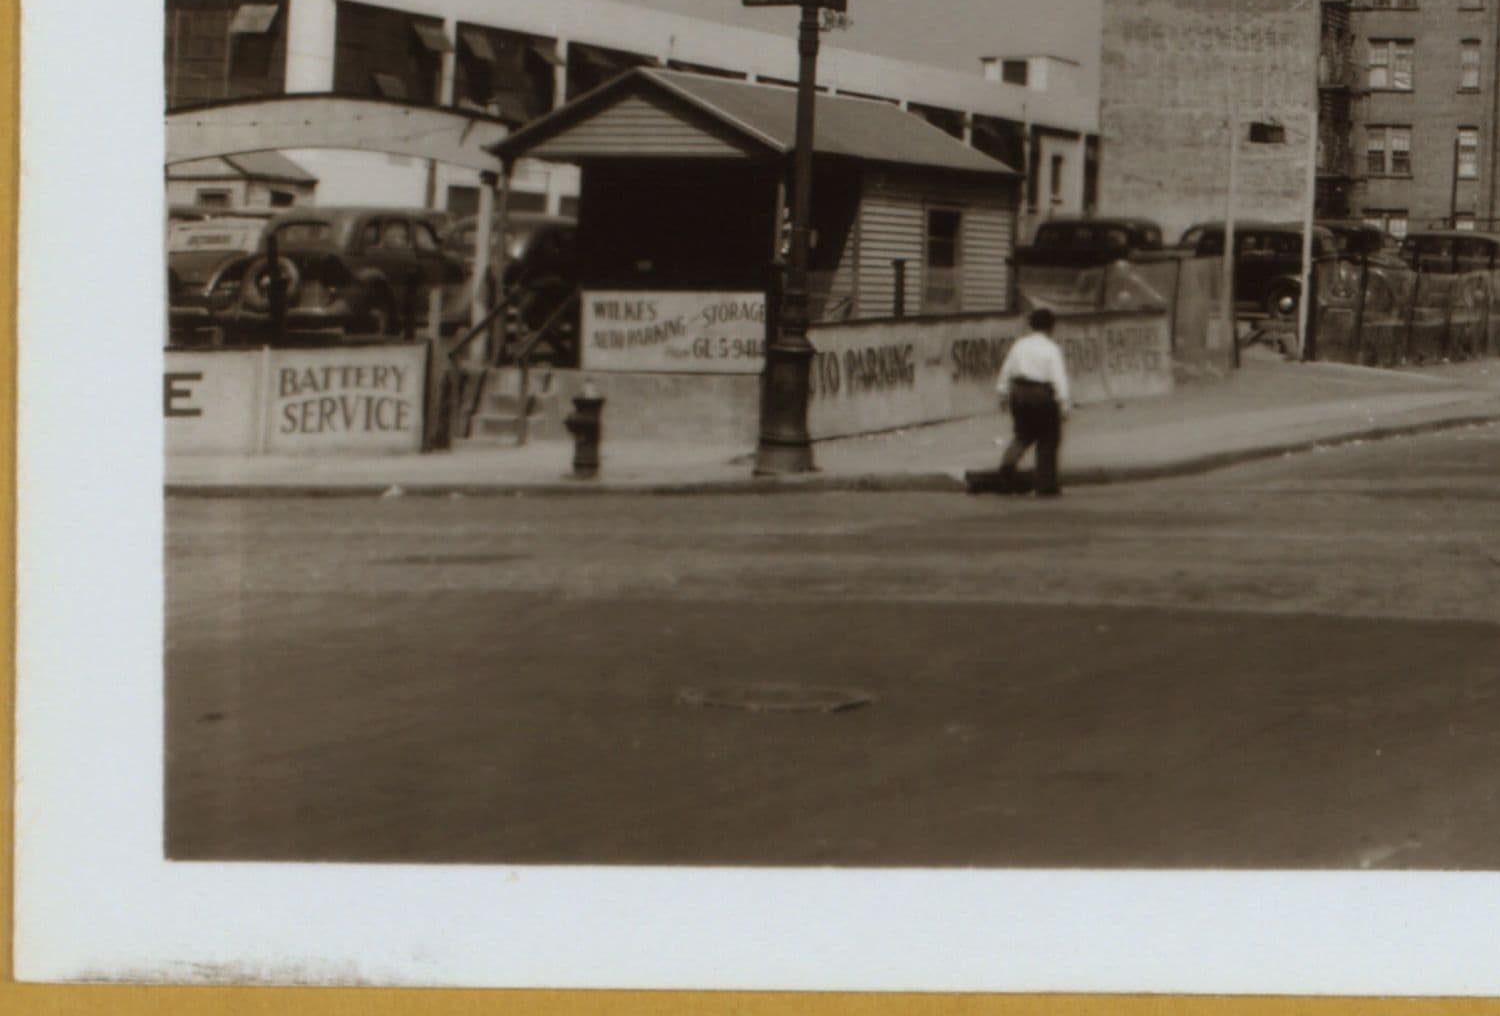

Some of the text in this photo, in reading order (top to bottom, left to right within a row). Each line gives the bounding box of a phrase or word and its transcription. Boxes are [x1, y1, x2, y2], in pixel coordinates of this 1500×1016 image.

[592, 300, 658, 321] WILKES
[593, 300, 765, 350] AUTO PARKING STORAGE
[279, 365, 406, 398] BATTERY
[809, 351, 840, 395] TO
[846, 344, 915, 393] PARKING
[950, 336, 1016, 382] STORAG
[280, 395, 412, 434] SERVICE
